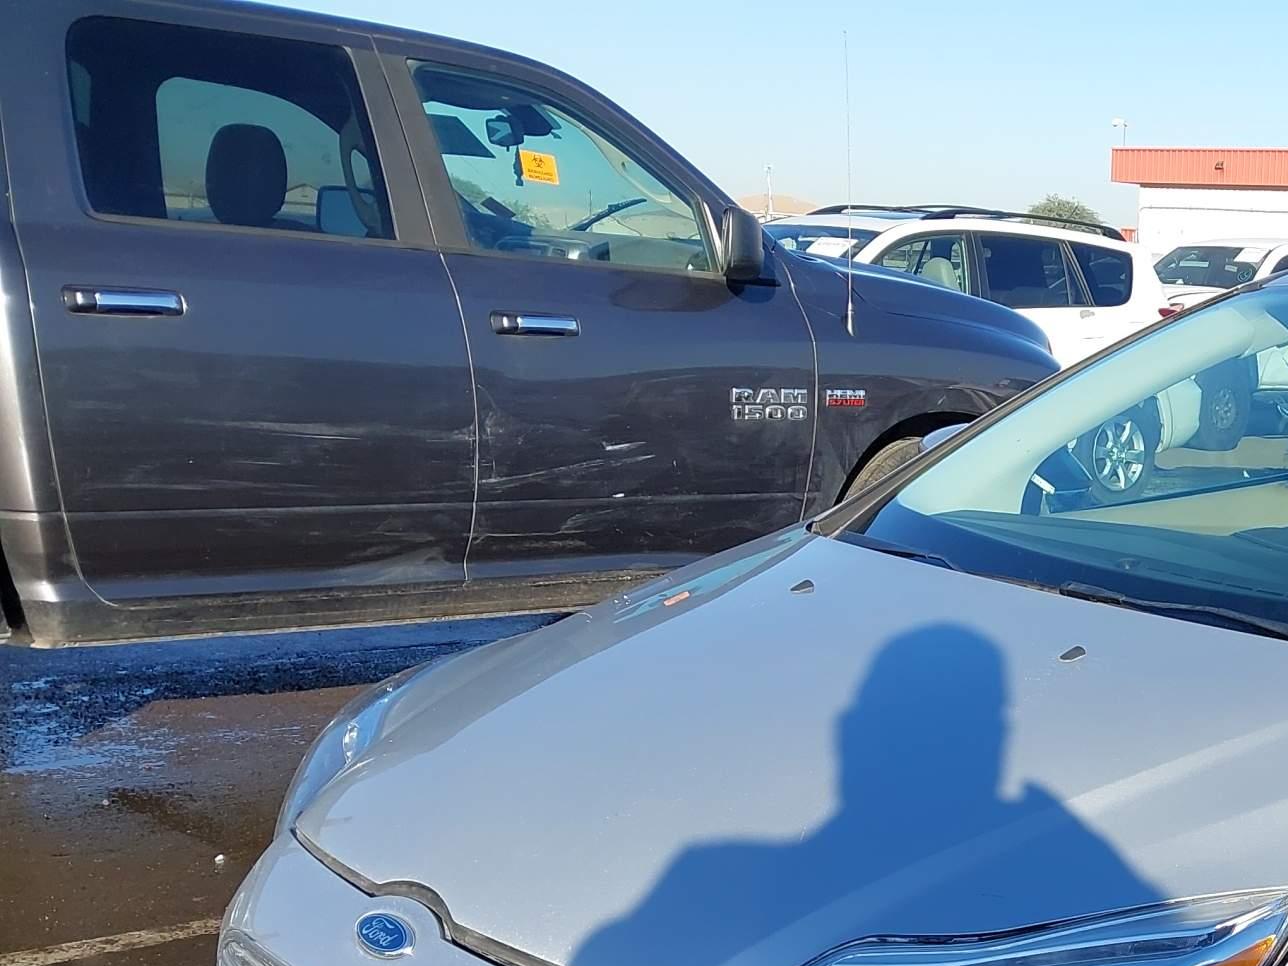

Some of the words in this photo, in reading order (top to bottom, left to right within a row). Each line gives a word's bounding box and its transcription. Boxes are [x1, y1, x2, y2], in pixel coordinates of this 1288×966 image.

[731, 387, 808, 404] RAM
[731, 404, 808, 421] 1500
[361, 917, 400, 947] Ford
